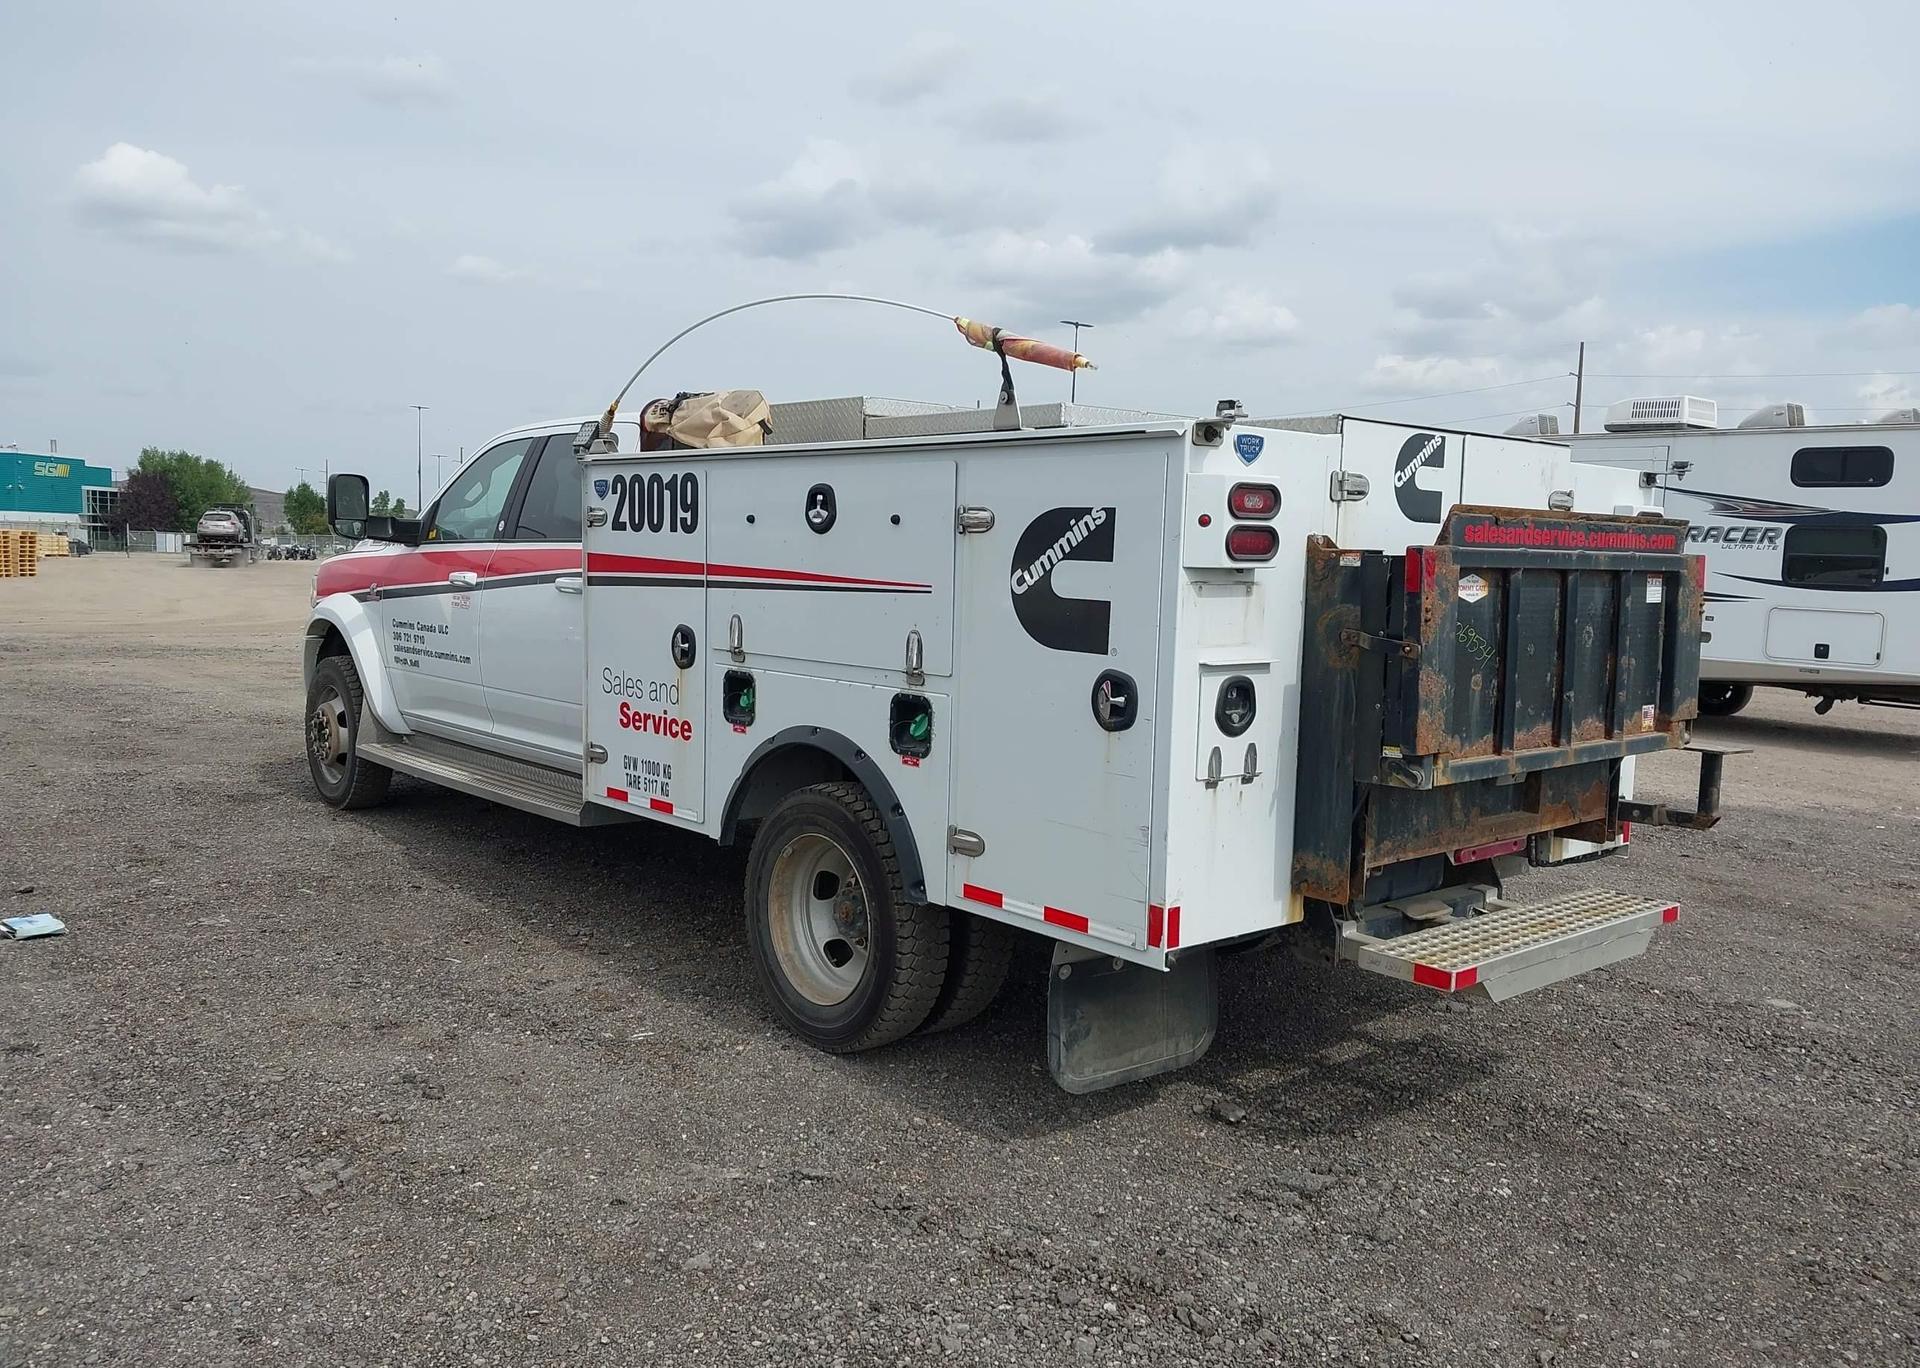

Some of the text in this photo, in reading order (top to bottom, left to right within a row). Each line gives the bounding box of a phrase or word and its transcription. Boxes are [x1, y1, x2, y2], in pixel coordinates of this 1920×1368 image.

[1240, 445, 1260, 453] TRUCK
[1241, 437, 1260, 445] WORK
[1395, 434, 1443, 488] Cummins
[611, 472, 699, 535] 20019
[1464, 522, 1676, 549] salesandservice.cummins.com
[1010, 506, 1107, 595] Cummins
[392, 618, 449, 635] Cummins Canada ULC
[393, 644, 472, 664] salesandservice.cummins.com
[602, 667, 680, 705] Sales and
[619, 702, 693, 741] Service
[623, 755, 672, 780] GVW 11000 KG
[625, 773, 670, 797] TARE 5117 KG
